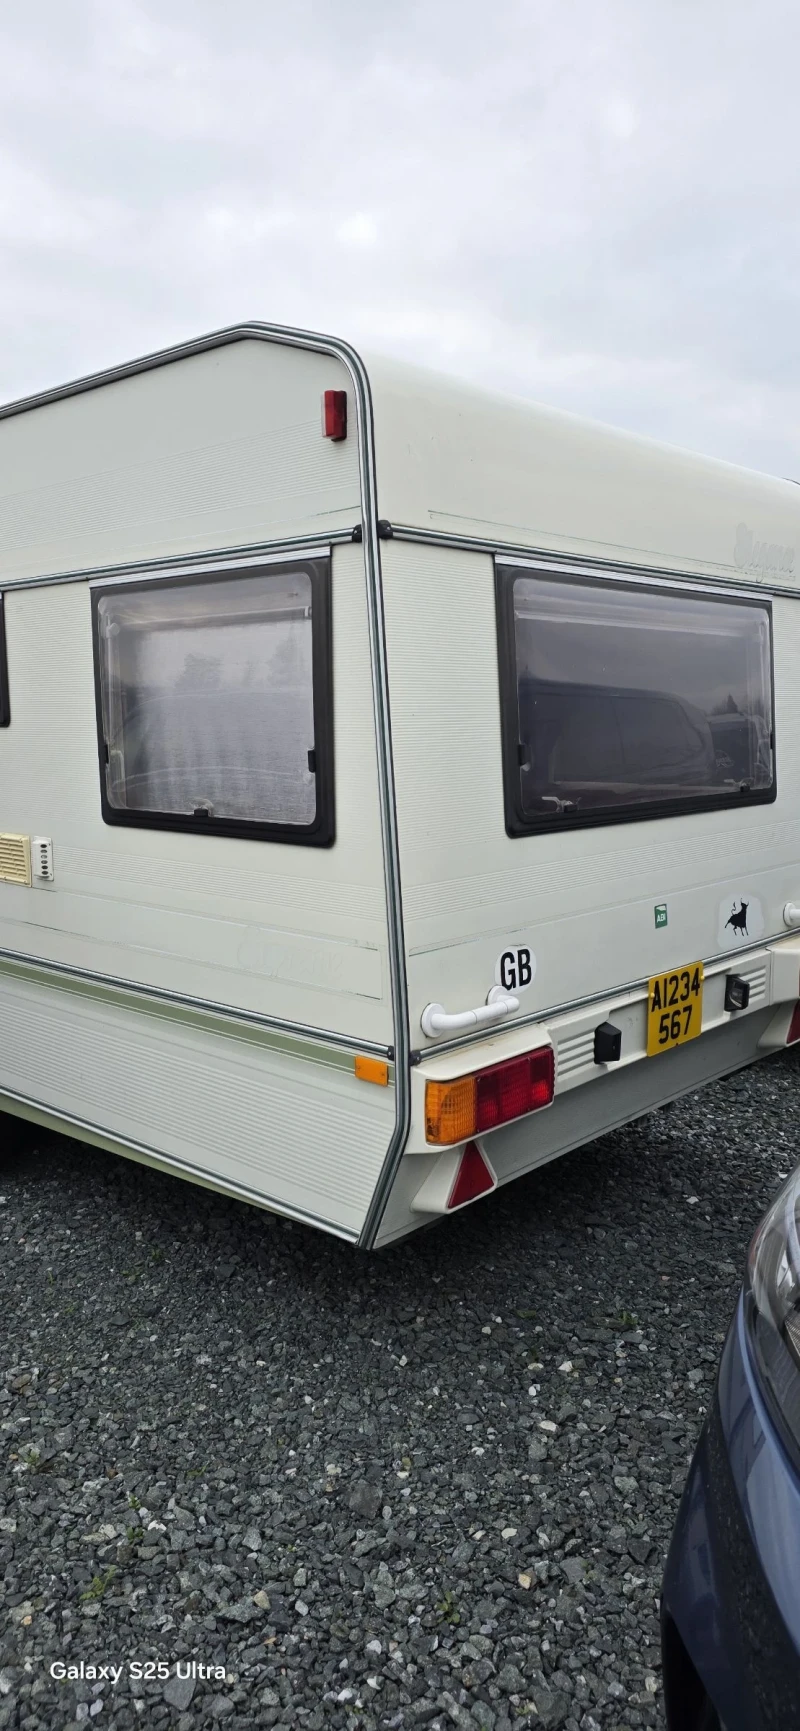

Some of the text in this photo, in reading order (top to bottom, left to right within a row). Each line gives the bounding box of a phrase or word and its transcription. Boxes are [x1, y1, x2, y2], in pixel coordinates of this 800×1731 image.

[501, 949, 532, 991] GB
[651, 968, 700, 1012] A1234
[659, 1005, 693, 1044] 567
